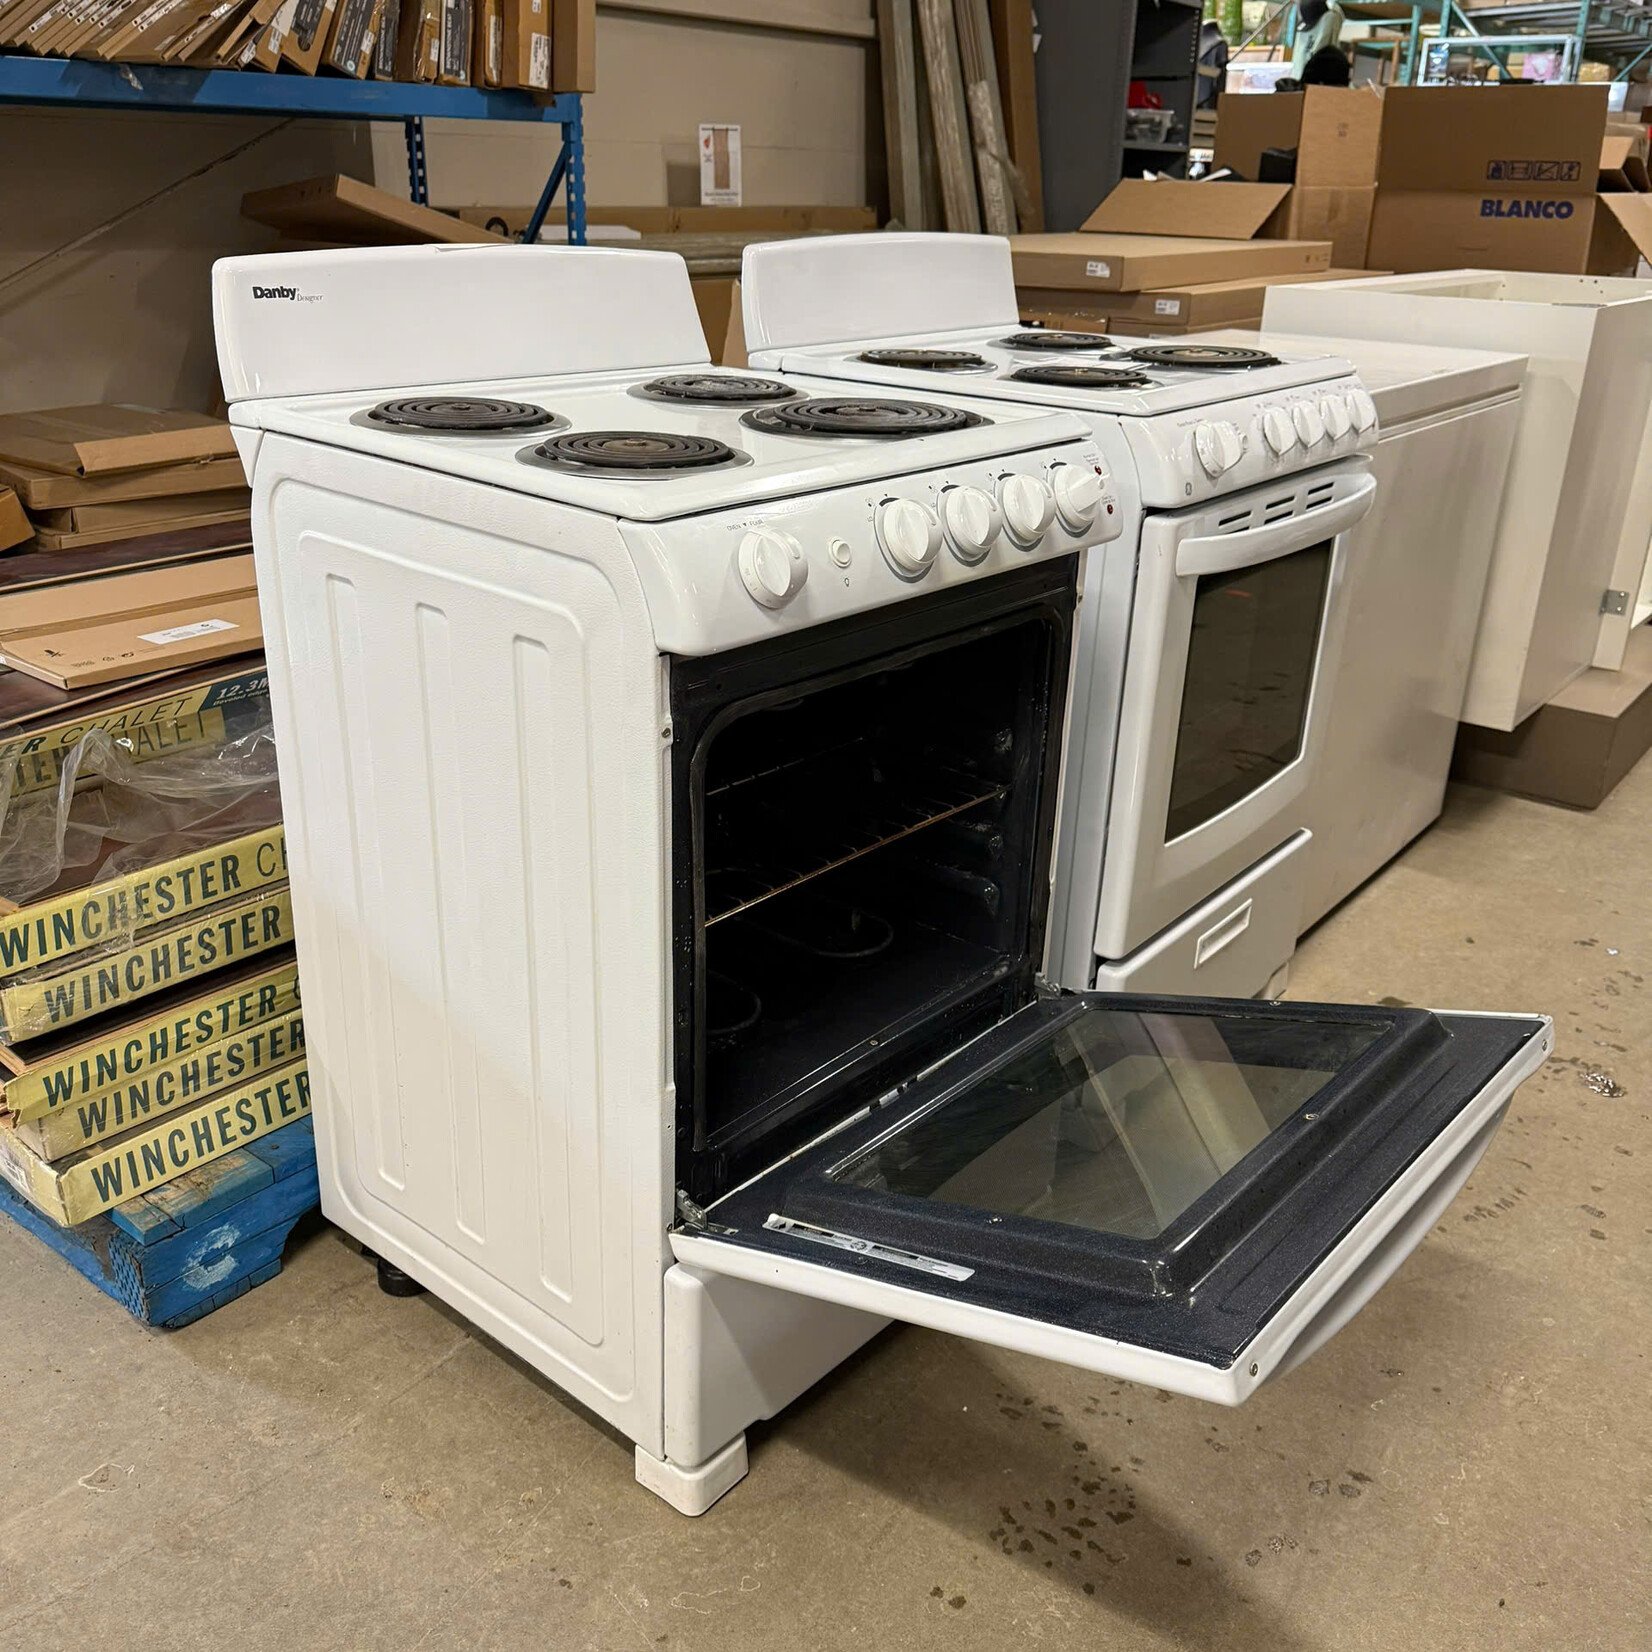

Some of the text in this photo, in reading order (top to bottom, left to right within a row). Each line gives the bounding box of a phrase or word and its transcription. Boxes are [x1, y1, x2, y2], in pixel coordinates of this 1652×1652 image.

[1480, 199, 1574, 219] BLANCO
[252, 286, 296, 301] Danby
[0, 854, 242, 969] WINCHESTER
[44, 905, 281, 1023] WINCHESTER
[43, 984, 278, 1108] WINCHESTER
[78, 1018, 305, 1139] WINCHESTER
[91, 1071, 313, 1203] WINCHESTER
